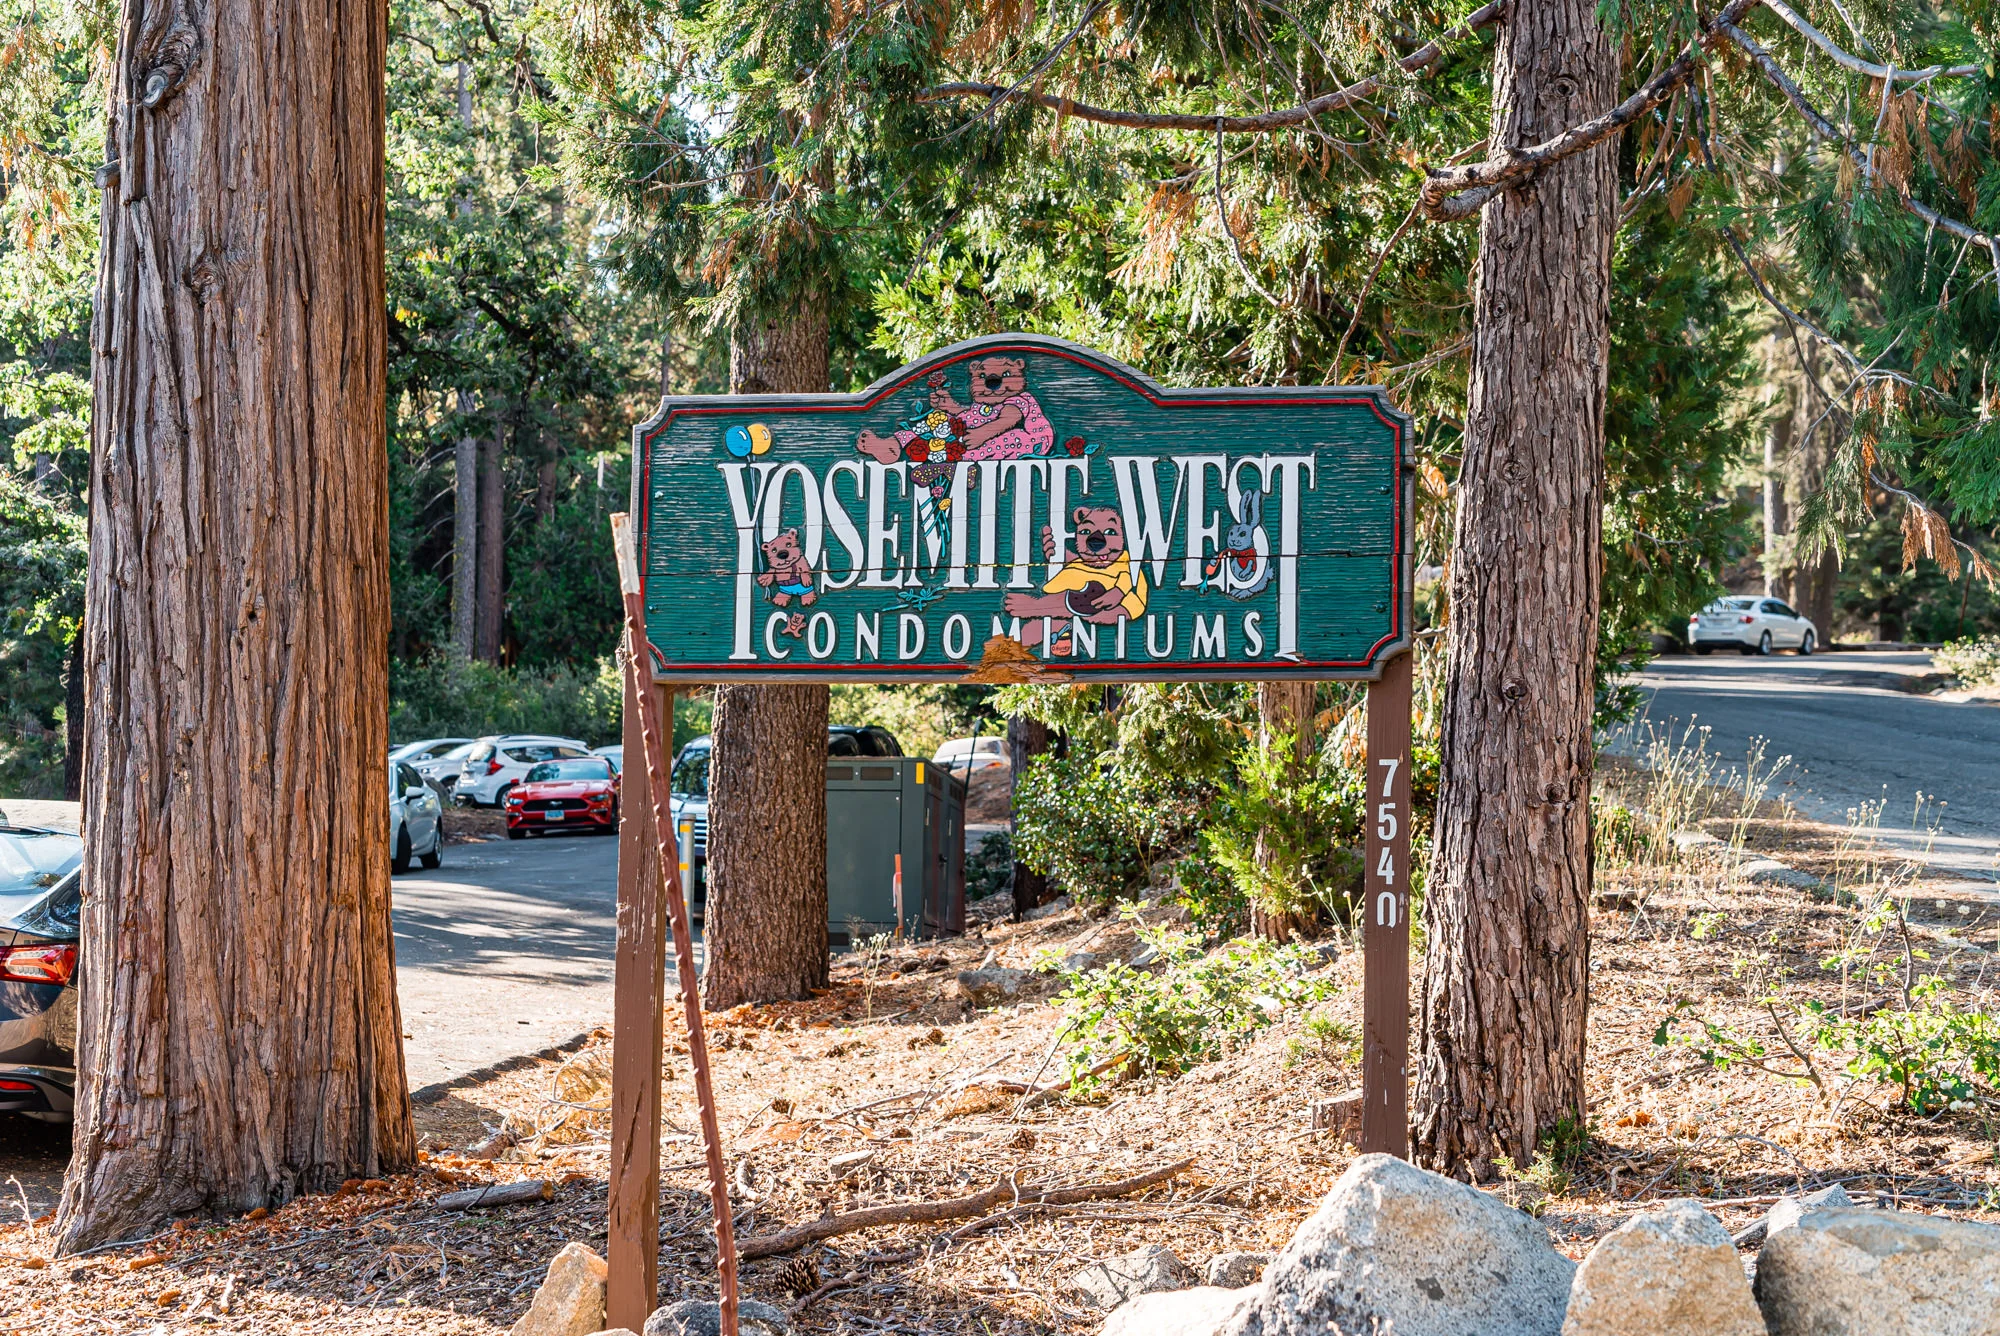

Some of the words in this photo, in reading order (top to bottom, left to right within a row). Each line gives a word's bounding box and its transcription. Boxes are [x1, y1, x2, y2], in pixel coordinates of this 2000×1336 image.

[718, 454, 1088, 660] YOSEMITE
[1107, 453, 1316, 662] WEST
[1376, 758, 1399, 929] 7540
